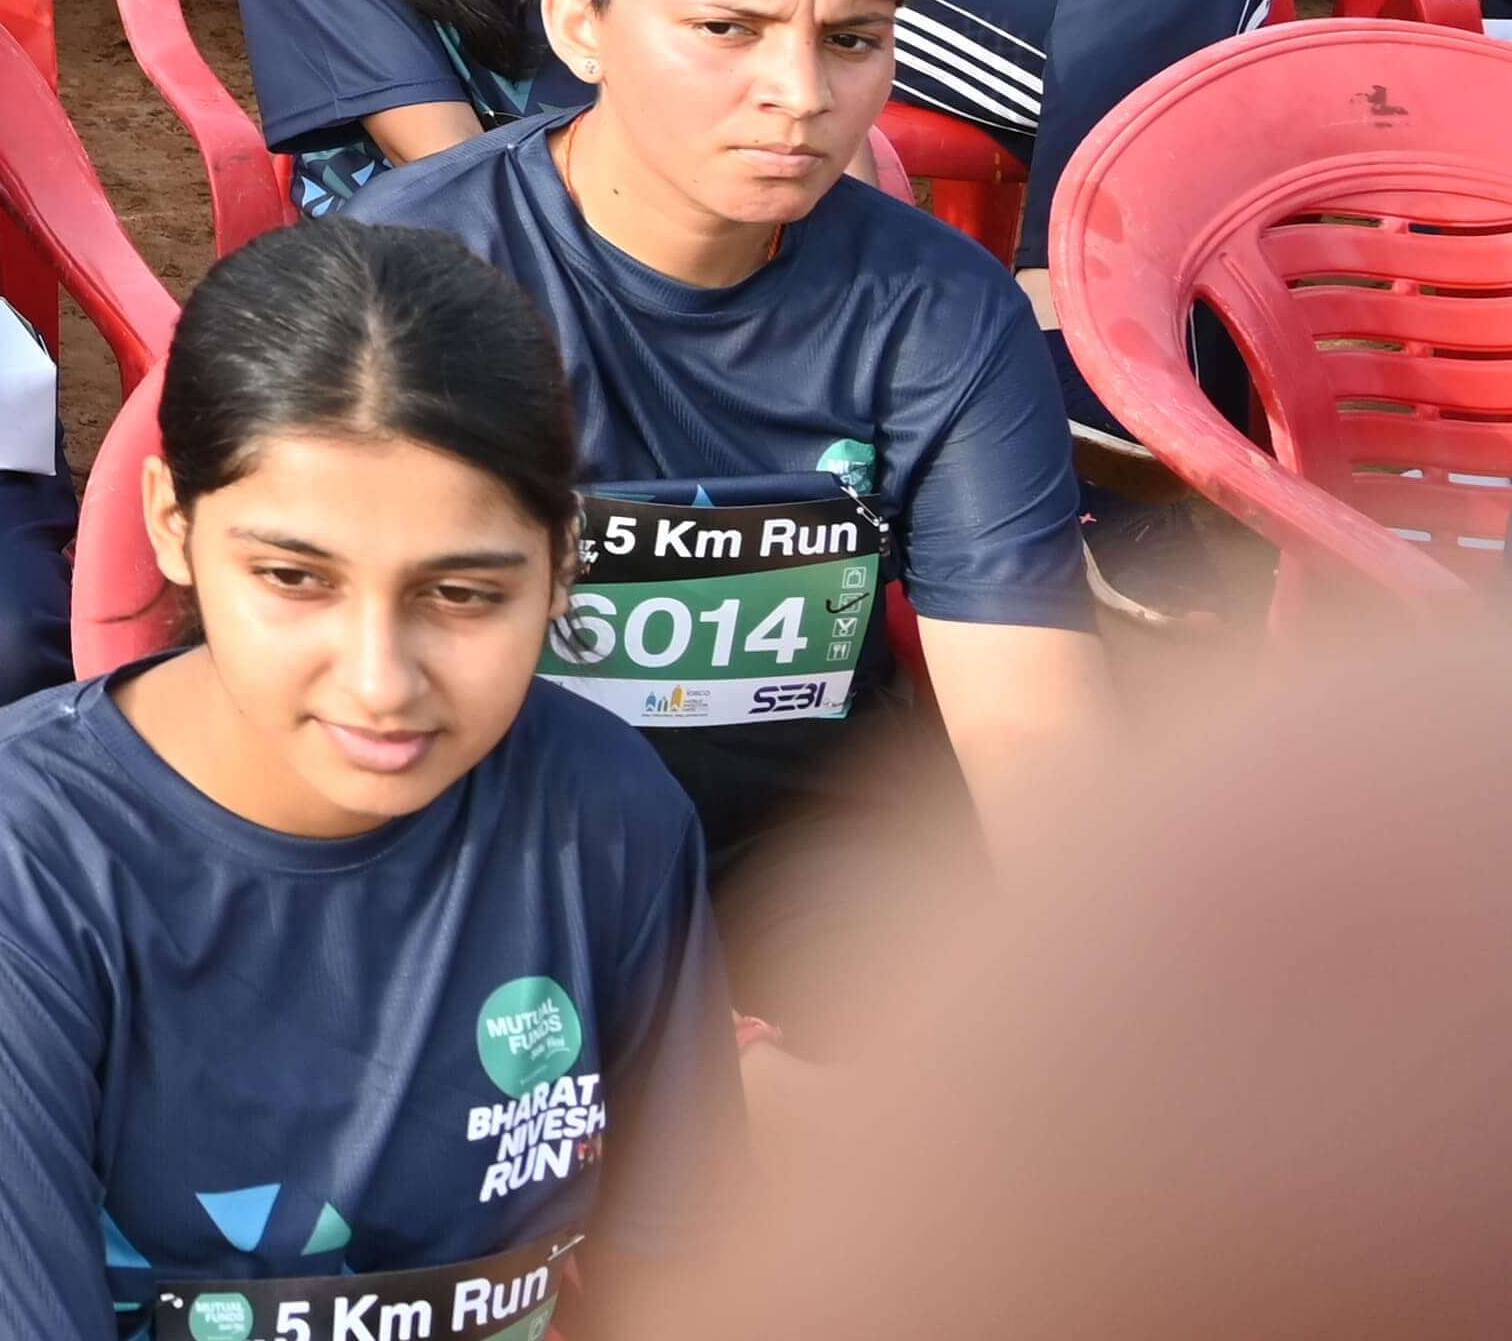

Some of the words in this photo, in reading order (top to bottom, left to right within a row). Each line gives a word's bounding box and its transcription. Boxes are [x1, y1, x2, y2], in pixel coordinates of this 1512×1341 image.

[603, 515, 637, 555] 5
[654, 519, 742, 558] Km
[760, 519, 858, 558] Run
[550, 593, 809, 669] 6014
[748, 681, 829, 716] SEBI
[486, 997, 560, 1039] MUTUAL
[508, 1014, 563, 1055] FUNDS
[466, 1073, 601, 1142] BHARAT
[497, 1105, 606, 1163] NIVESH
[479, 1140, 573, 1203] RUN
[275, 1300, 313, 1341] 5
[332, 1293, 432, 1341] Km
[450, 1265, 550, 1330] Run
